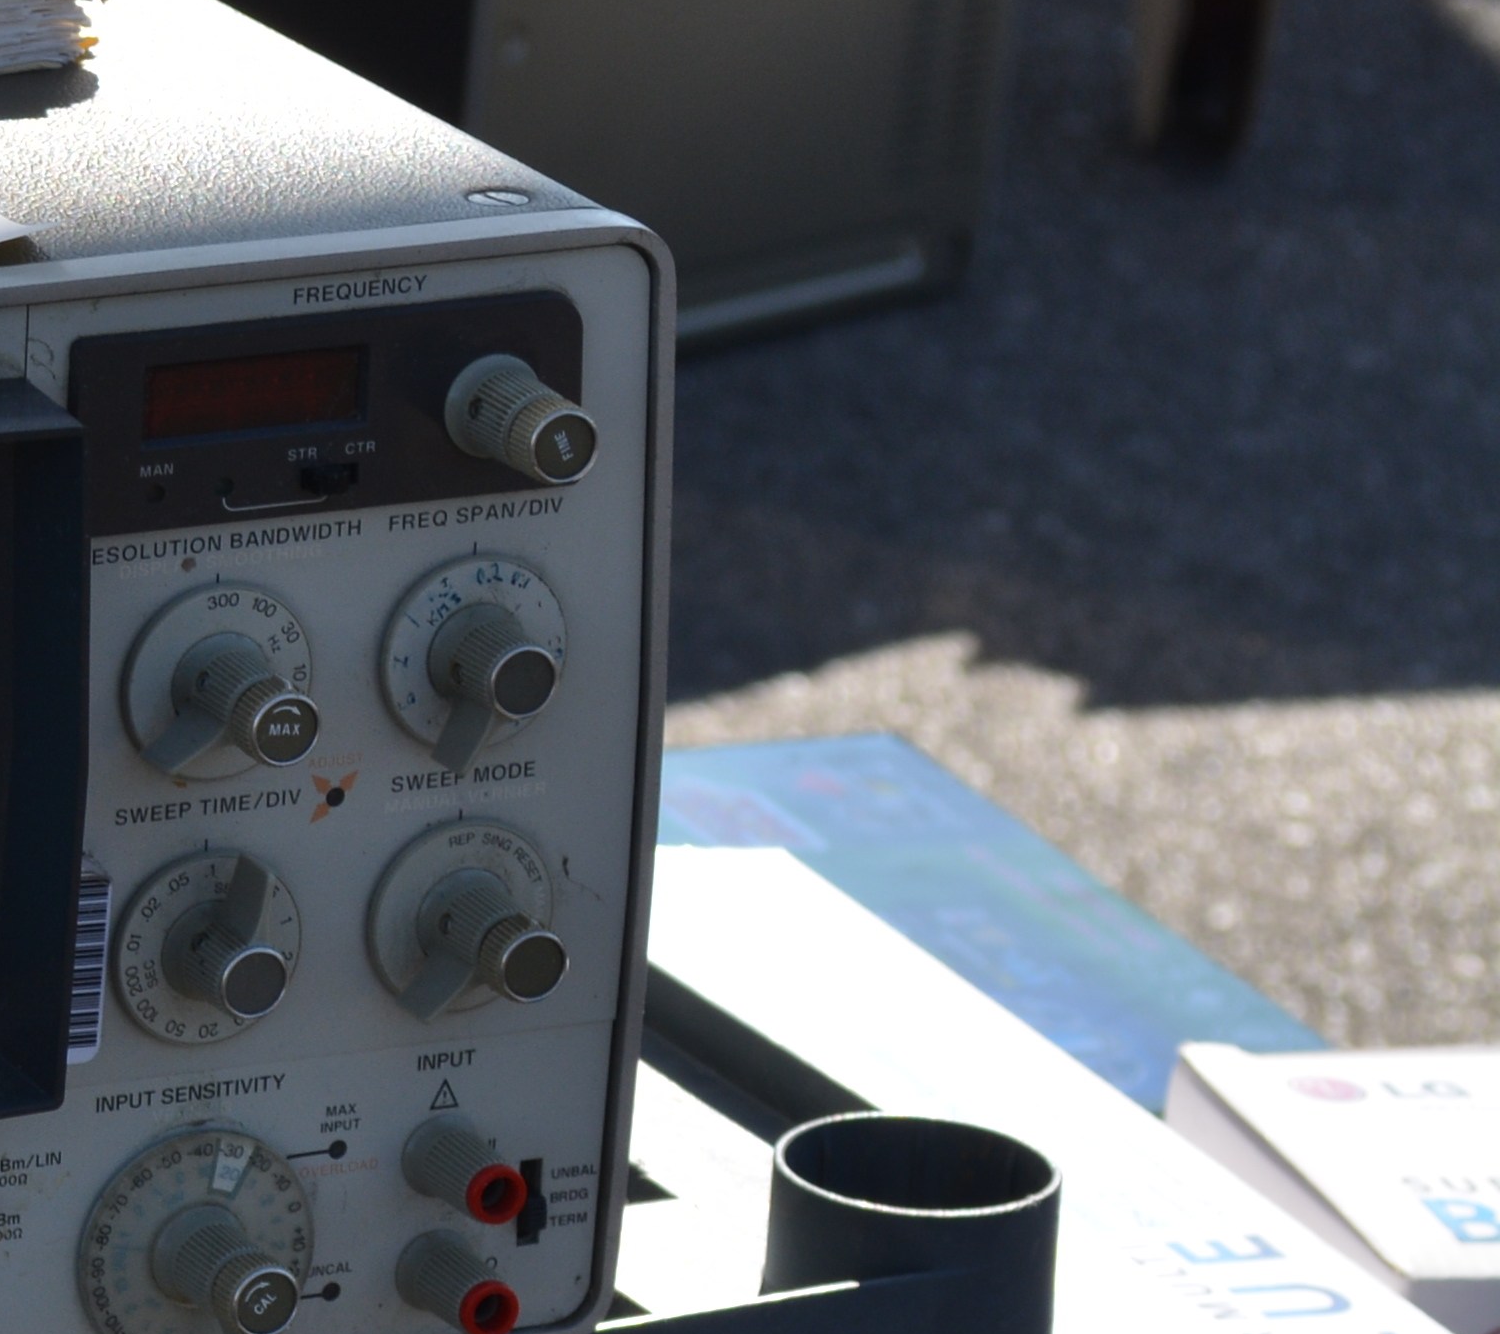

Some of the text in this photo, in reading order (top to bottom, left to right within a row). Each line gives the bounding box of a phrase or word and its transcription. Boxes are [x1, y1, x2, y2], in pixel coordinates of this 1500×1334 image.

[293, 276, 427, 305] FREQUENCY
[140, 462, 174, 478] MAN
[388, 496, 563, 532] FREQ SPAN/DIV
[92, 519, 362, 566] ESOLUTION BANDWIDTH
[207, 592, 240, 610] 300
[252, 596, 277, 618] 100
[268, 722, 300, 737] MAX
[114, 788, 302, 826] SWEEP TIME/DIV
[448, 833, 475, 848] REP
[416, 1050, 476, 1071] INPUT
[96, 1074, 285, 1112] INPUT SENSITIVITY
[325, 1103, 357, 1118] MAX
[320, 1118, 361, 1133] INPUT
[552, 1164, 597, 1179] UNBAL
[550, 1188, 588, 1202] BRDG
[549, 1212, 588, 1226] TERM
